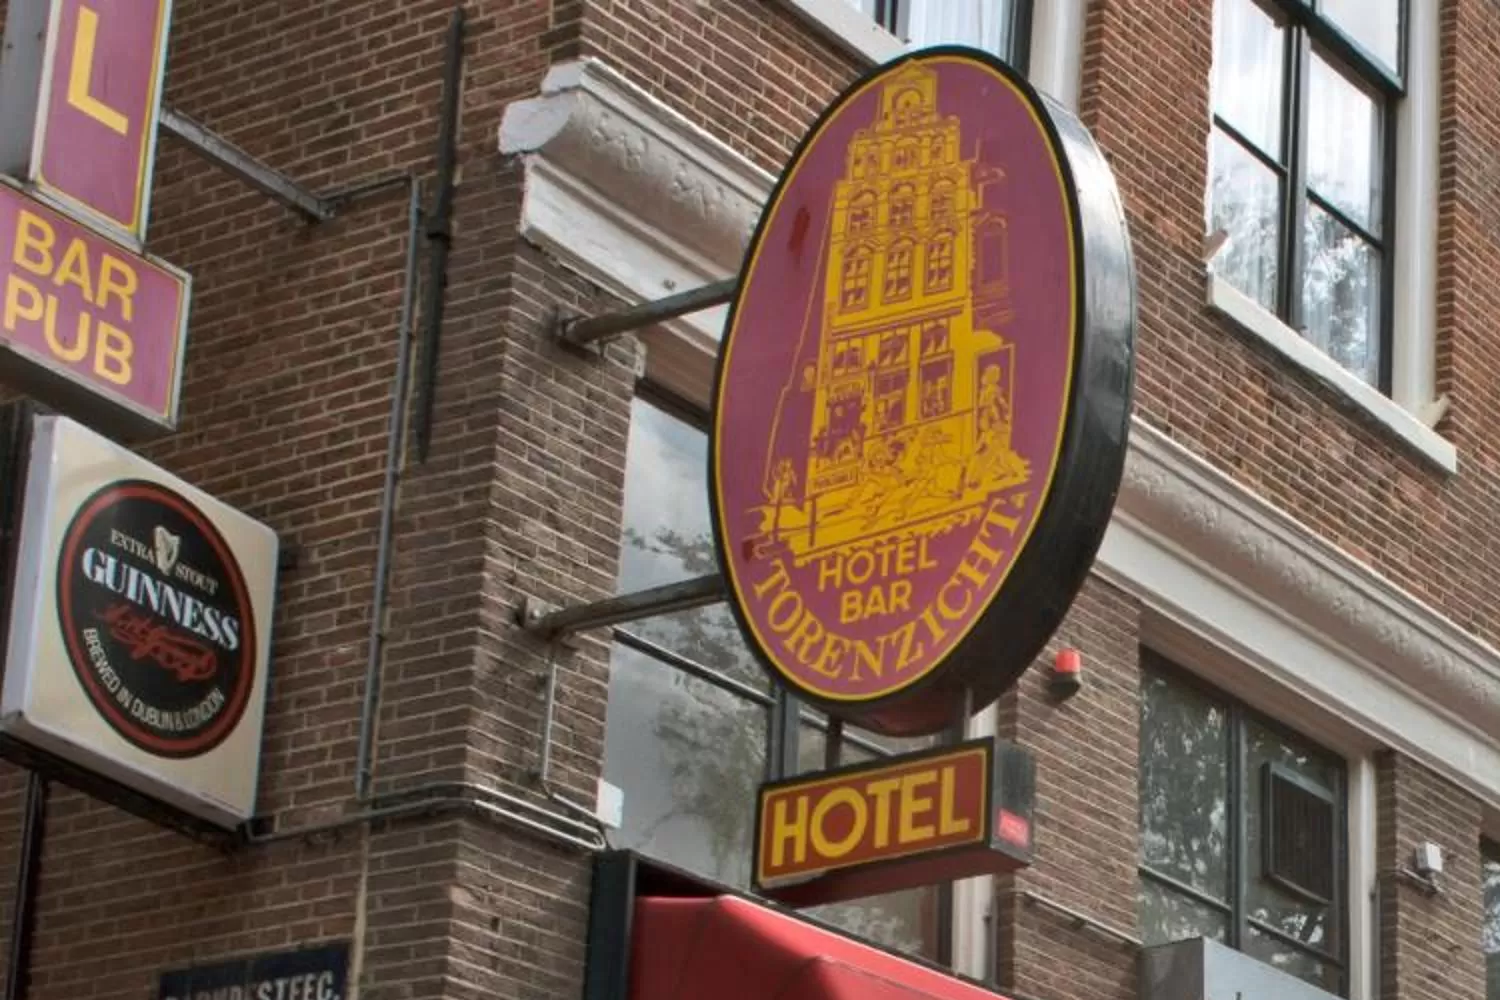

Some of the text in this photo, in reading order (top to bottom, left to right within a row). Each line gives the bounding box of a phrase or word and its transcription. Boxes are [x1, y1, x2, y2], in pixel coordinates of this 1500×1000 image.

[12, 208, 139, 323] BAR
[3, 273, 134, 386] PUB
[82, 547, 239, 650] GUINNESS
[110, 528, 219, 596] EXTRA STOUT
[752, 490, 1030, 681] TORENZICHT
[818, 538, 938, 593] HOTEL
[839, 580, 912, 625] BAR
[82, 626, 122, 694] BREWED
[116, 688, 132, 709] IN
[769, 766, 970, 869] HOTEL
